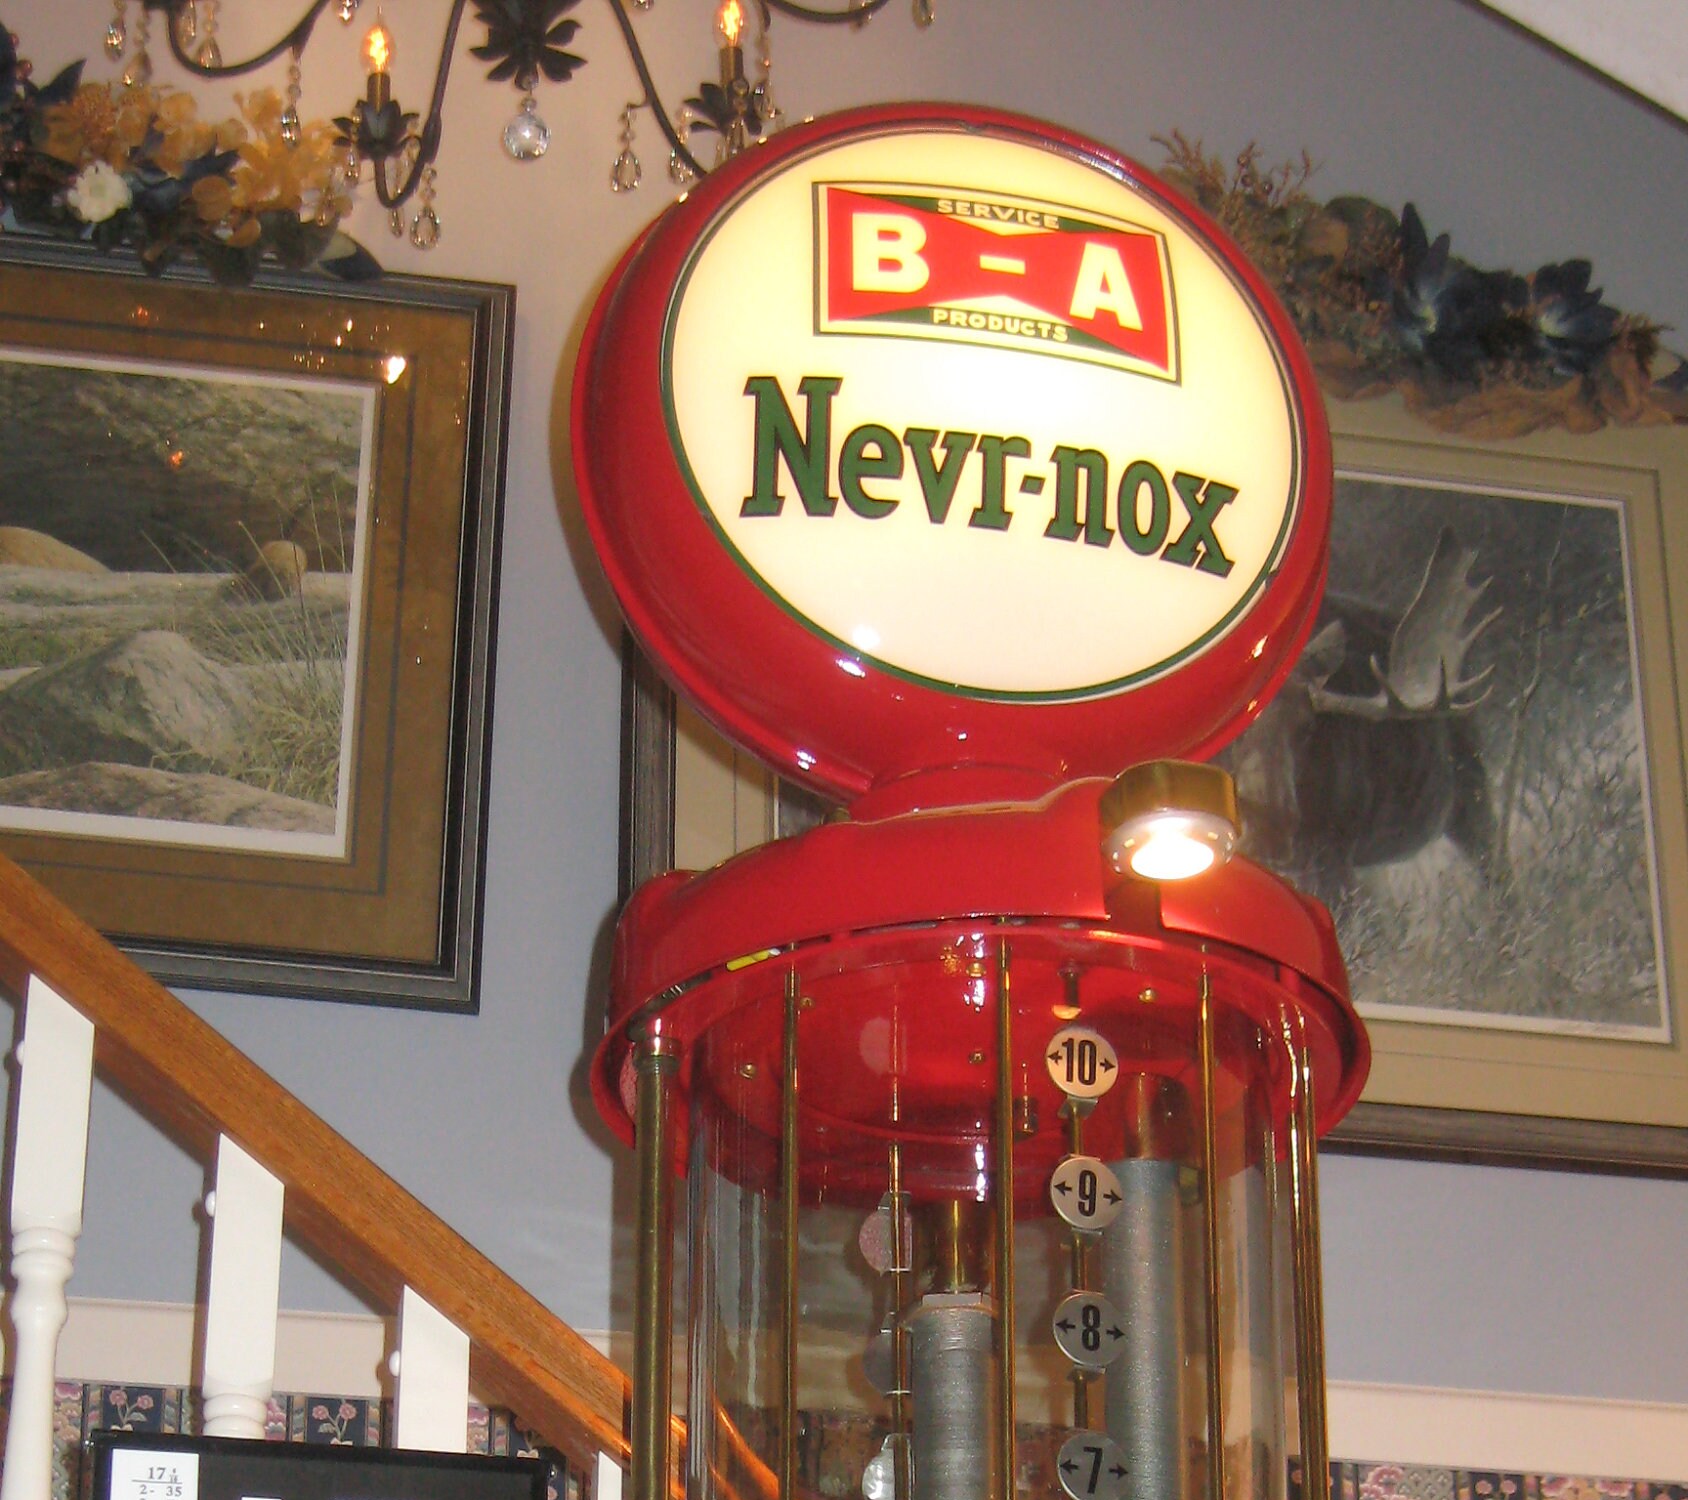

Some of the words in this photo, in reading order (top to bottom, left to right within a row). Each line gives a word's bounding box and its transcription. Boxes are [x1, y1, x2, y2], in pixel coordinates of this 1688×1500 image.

[937, 199, 1060, 230] SERVICE
[932, 308, 1068, 342] PRODUCTS
[740, 376, 1240, 577] Nevr-nox
[1062, 1038, 1097, 1086] 10
[1078, 1169, 1098, 1217] 9
[1081, 1304, 1101, 1351] 8
[148, 1466, 167, 1480] 17
[165, 1486, 182, 1497] 35
[1083, 1446, 1103, 1494] 7
